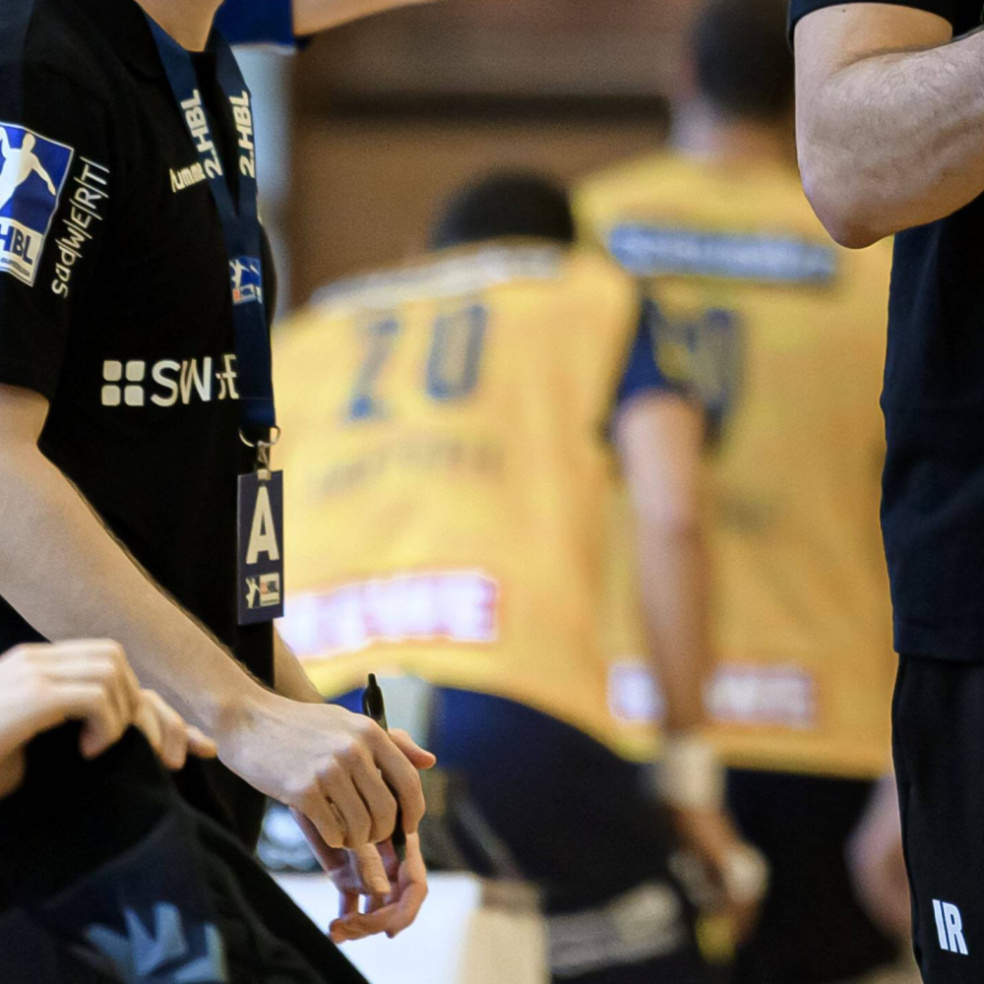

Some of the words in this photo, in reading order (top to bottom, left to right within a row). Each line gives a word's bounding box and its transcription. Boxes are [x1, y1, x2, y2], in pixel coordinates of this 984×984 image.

[181, 89, 223, 179] 2.HBL
[229, 90, 255, 179] 2.HBL
[245, 485, 280, 564] A
[932, 898, 969, 956] IR
